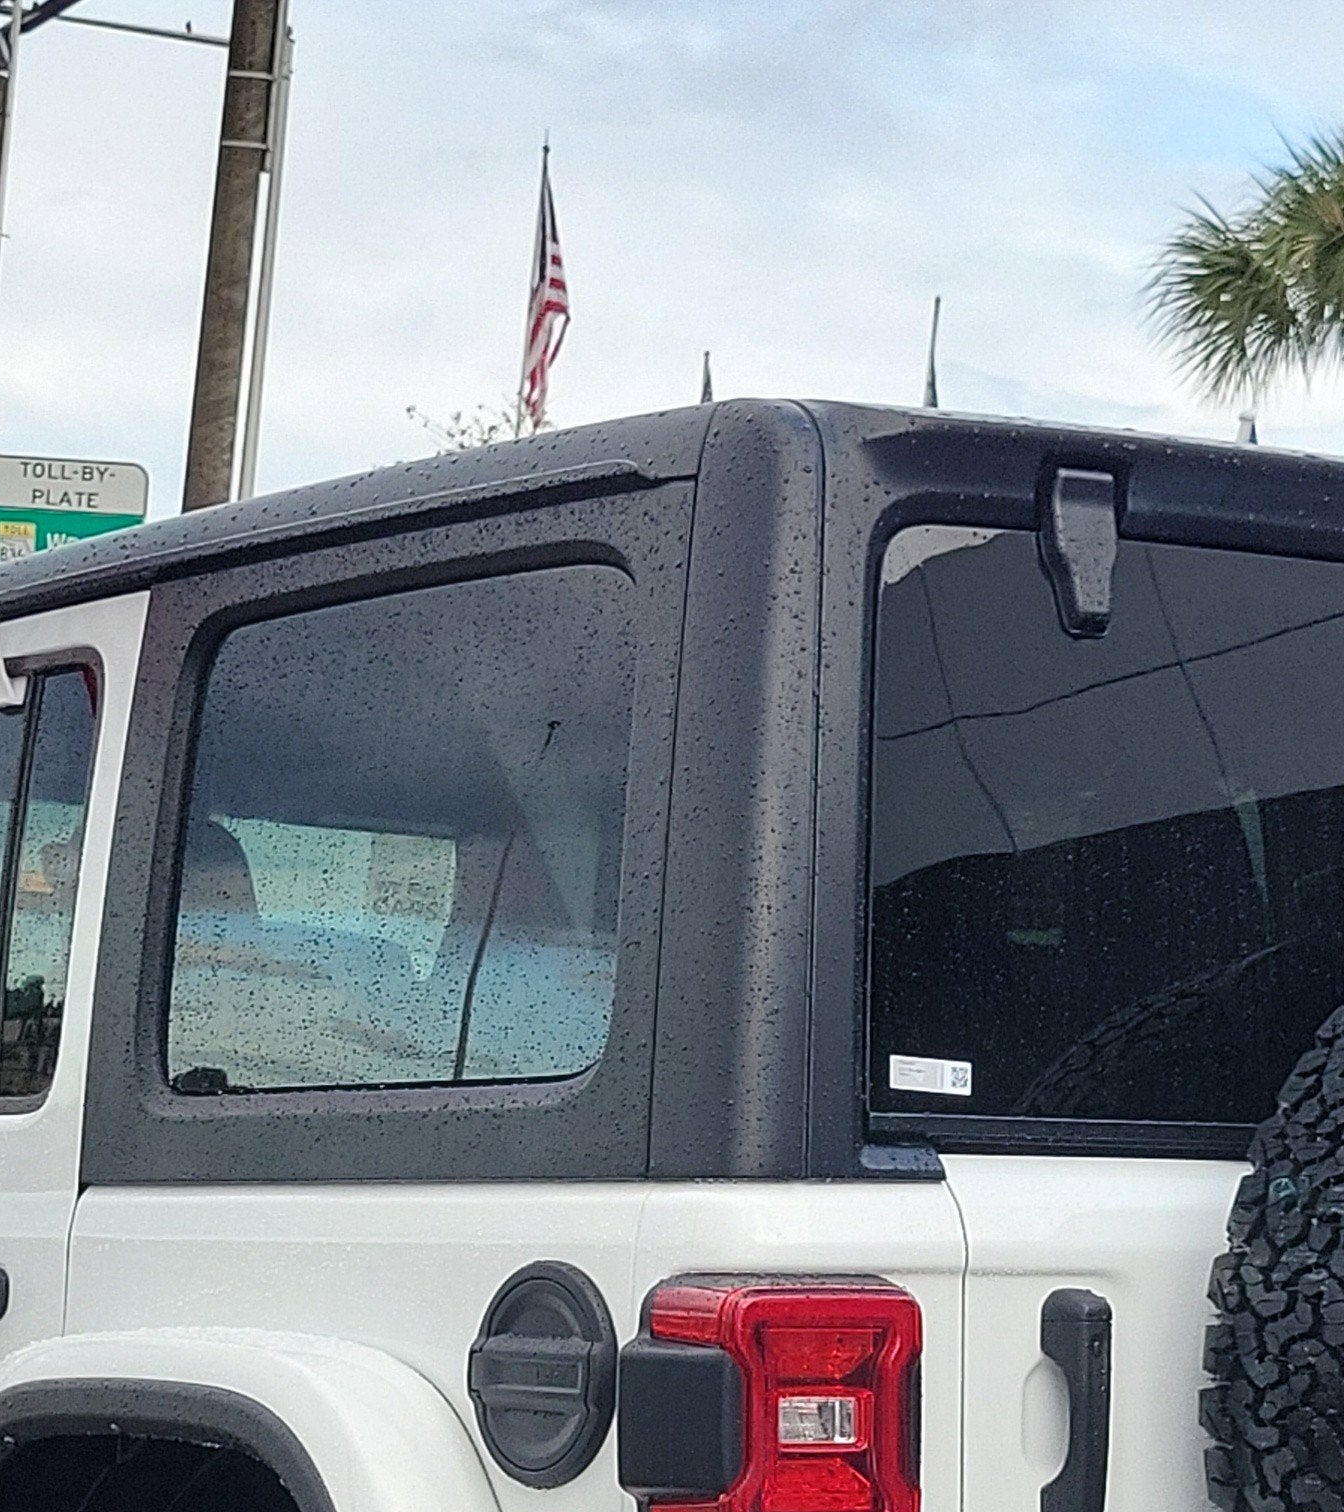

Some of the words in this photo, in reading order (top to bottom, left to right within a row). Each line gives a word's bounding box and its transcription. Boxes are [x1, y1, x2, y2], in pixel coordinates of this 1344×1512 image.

[20, 461, 116, 482] TOLL-BY-
[32, 488, 99, 508] PLATE
[3, 524, 30, 536] TOLL
